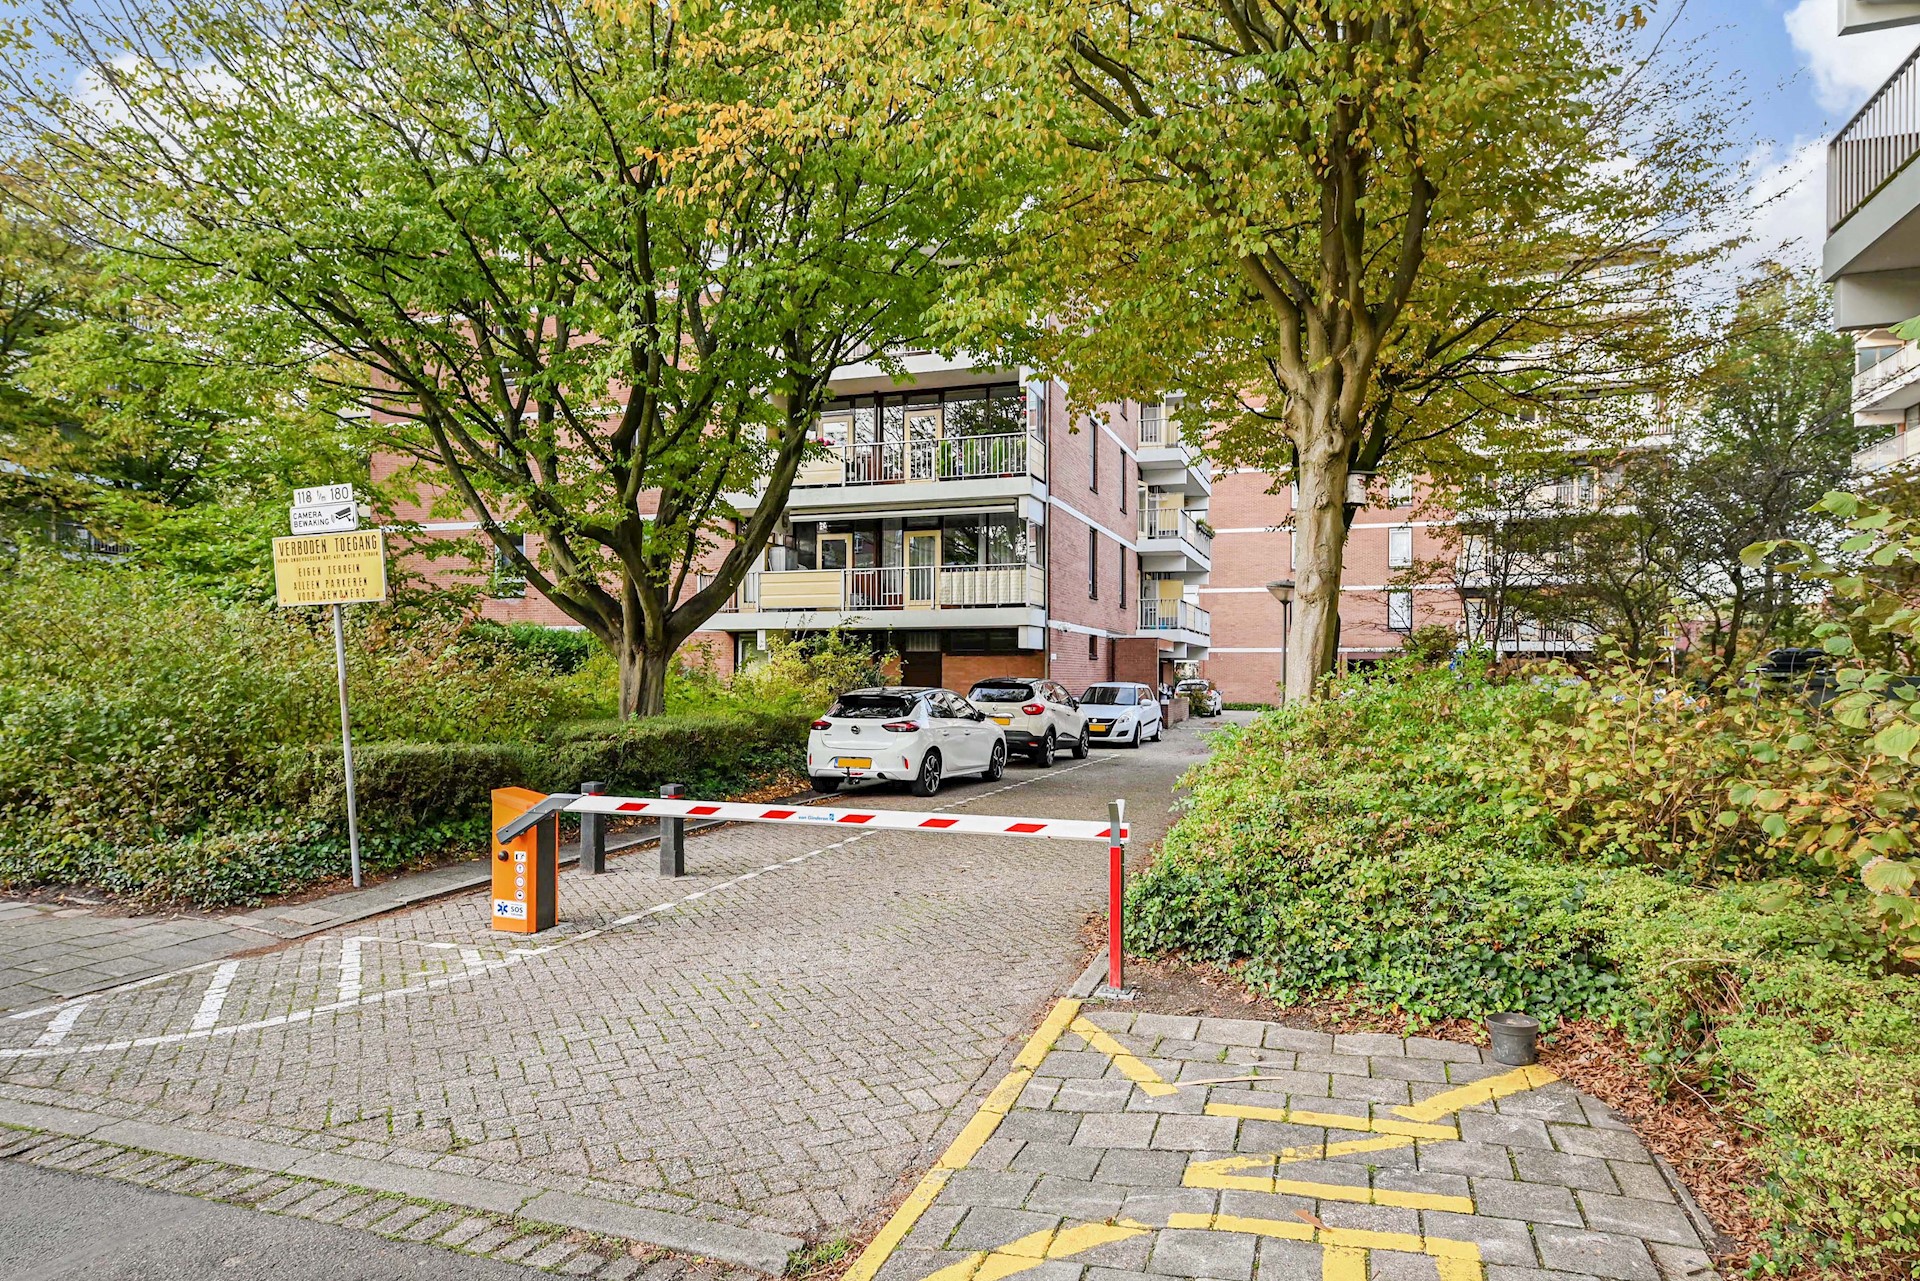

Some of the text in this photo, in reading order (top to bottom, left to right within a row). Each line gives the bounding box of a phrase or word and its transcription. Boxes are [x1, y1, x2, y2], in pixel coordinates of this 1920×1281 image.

[297, 490, 312, 504] 118
[330, 486, 349, 500] 180
[293, 511, 323, 520] CAMERA
[293, 518, 330, 528] BEWAKING
[278, 534, 378, 557] VERBODEN TOEGANG
[298, 563, 361, 577] EIGEN TERREIN
[293, 577, 368, 591] ALLEEN PARKEREN
[297, 588, 366, 601] VOOR BEWONERS
